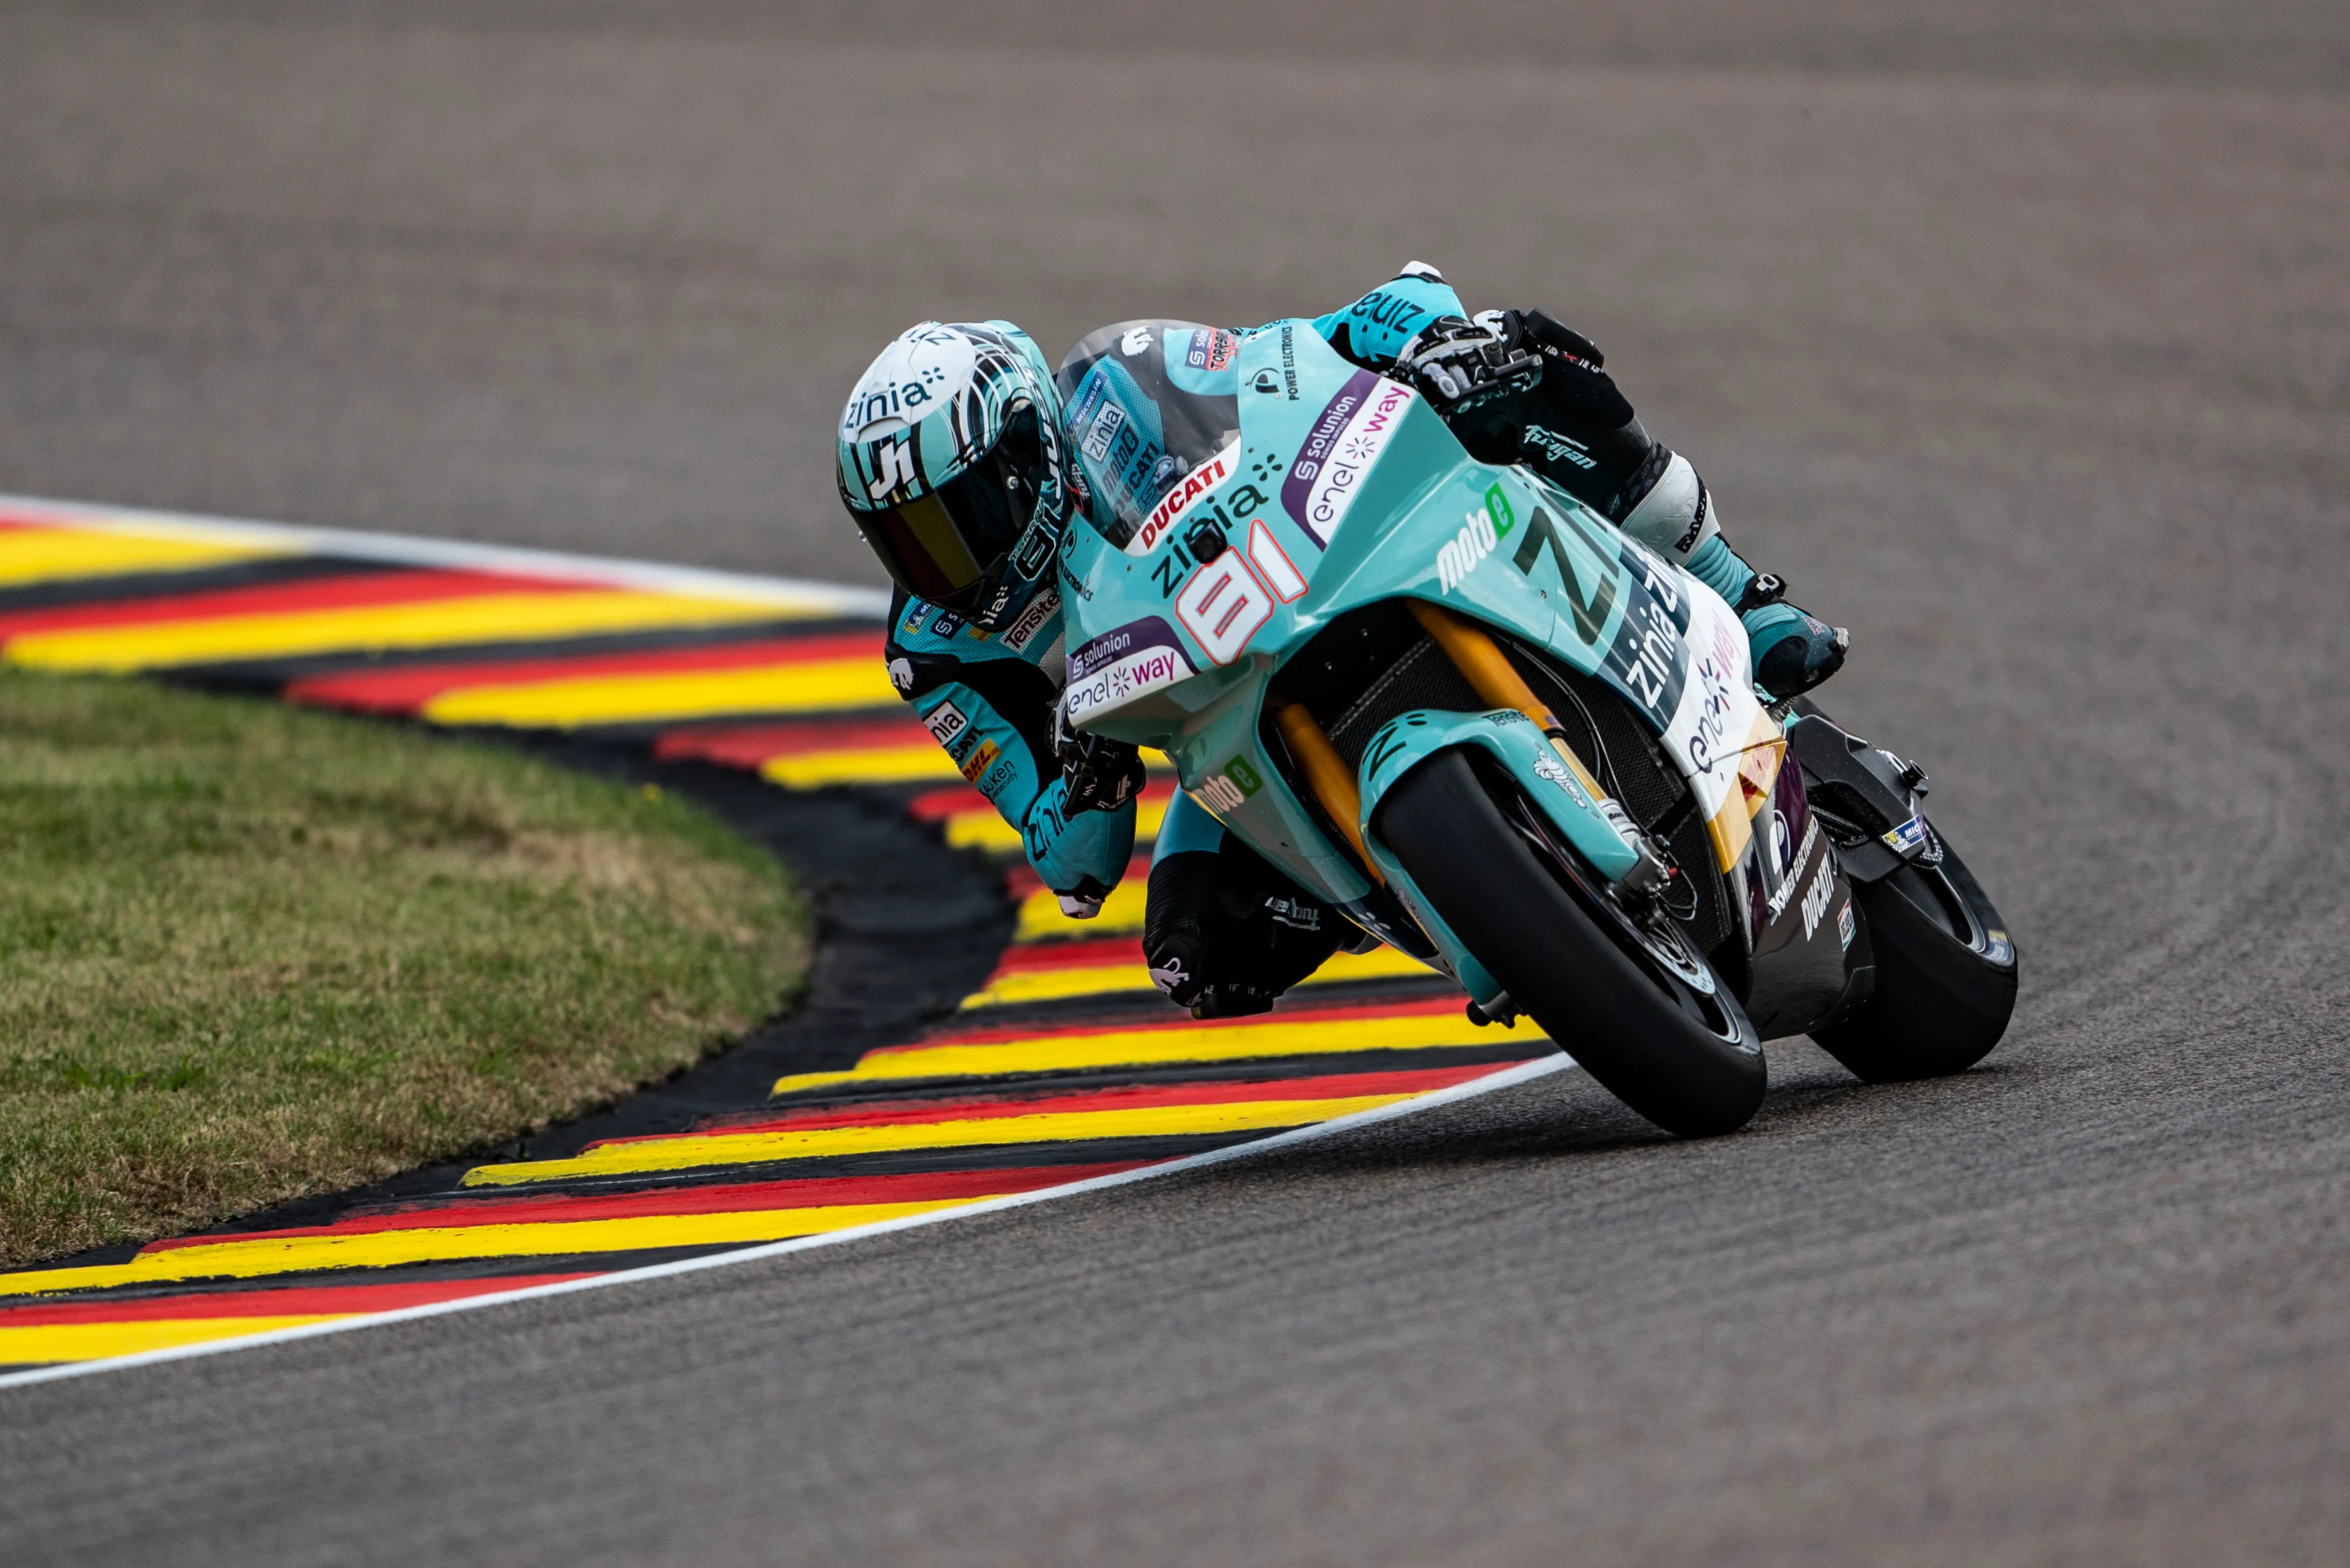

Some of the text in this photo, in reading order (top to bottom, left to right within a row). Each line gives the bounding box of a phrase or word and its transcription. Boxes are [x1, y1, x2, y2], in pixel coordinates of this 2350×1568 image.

[1281, 326, 1300, 401] POWER ELECTRONICS
[845, 382, 933, 428] zinia
[1089, 408, 1121, 457] zinia
[1307, 395, 1358, 458] solunion
[1113, 440, 1161, 513] DUCATI
[1313, 386, 1411, 523] enel way
[1140, 459, 1226, 551] DUCATI
[1174, 517, 1309, 667] 81
[1068, 651, 1175, 714] enel way
[1084, 632, 1131, 667] solunion
[1626, 601, 1678, 709] zinia
[1769, 868, 1796, 926] POWER
[1801, 852, 1835, 942] DUCATI
